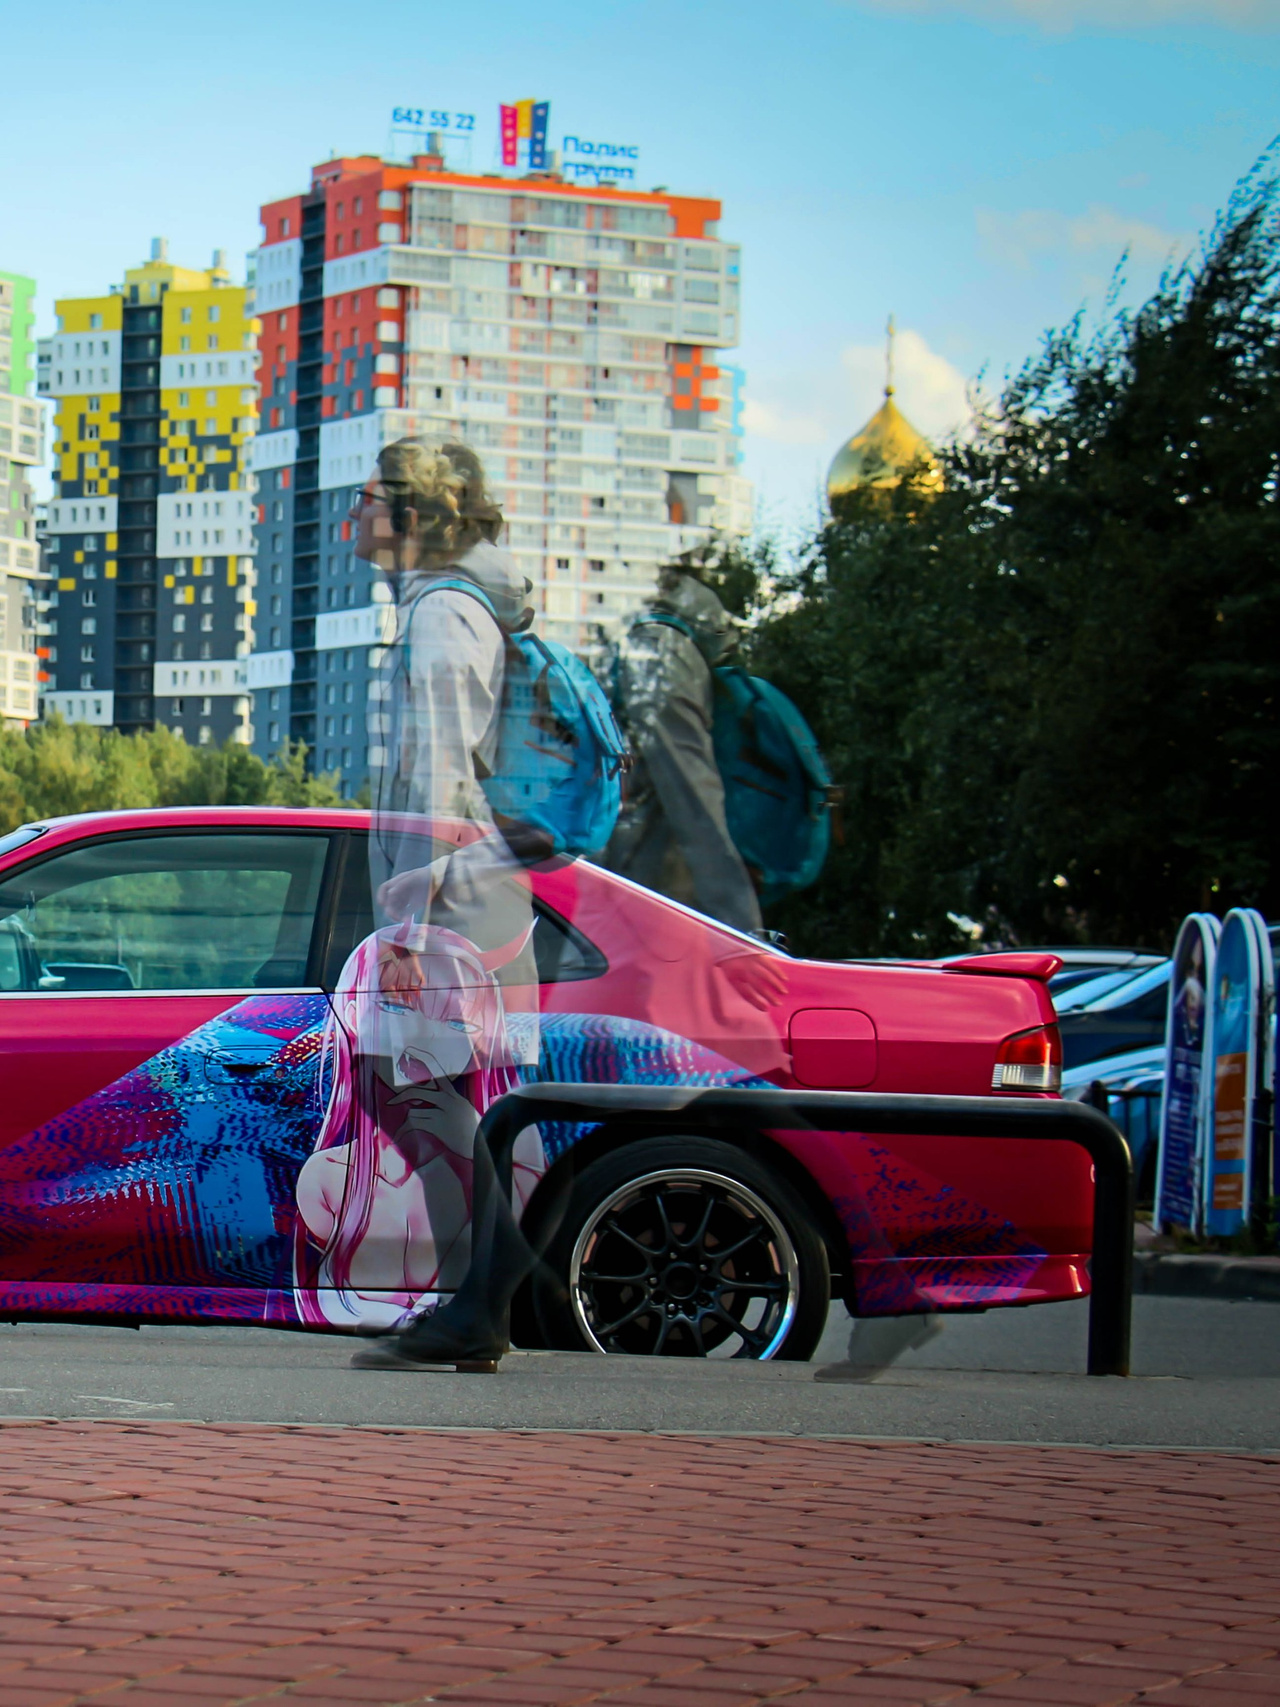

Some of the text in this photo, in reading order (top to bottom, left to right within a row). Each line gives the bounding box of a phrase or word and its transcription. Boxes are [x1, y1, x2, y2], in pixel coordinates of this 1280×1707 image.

[392, 107, 475, 130] 642 55 22
[563, 136, 639, 159] Полис
[563, 163, 634, 183] групп
